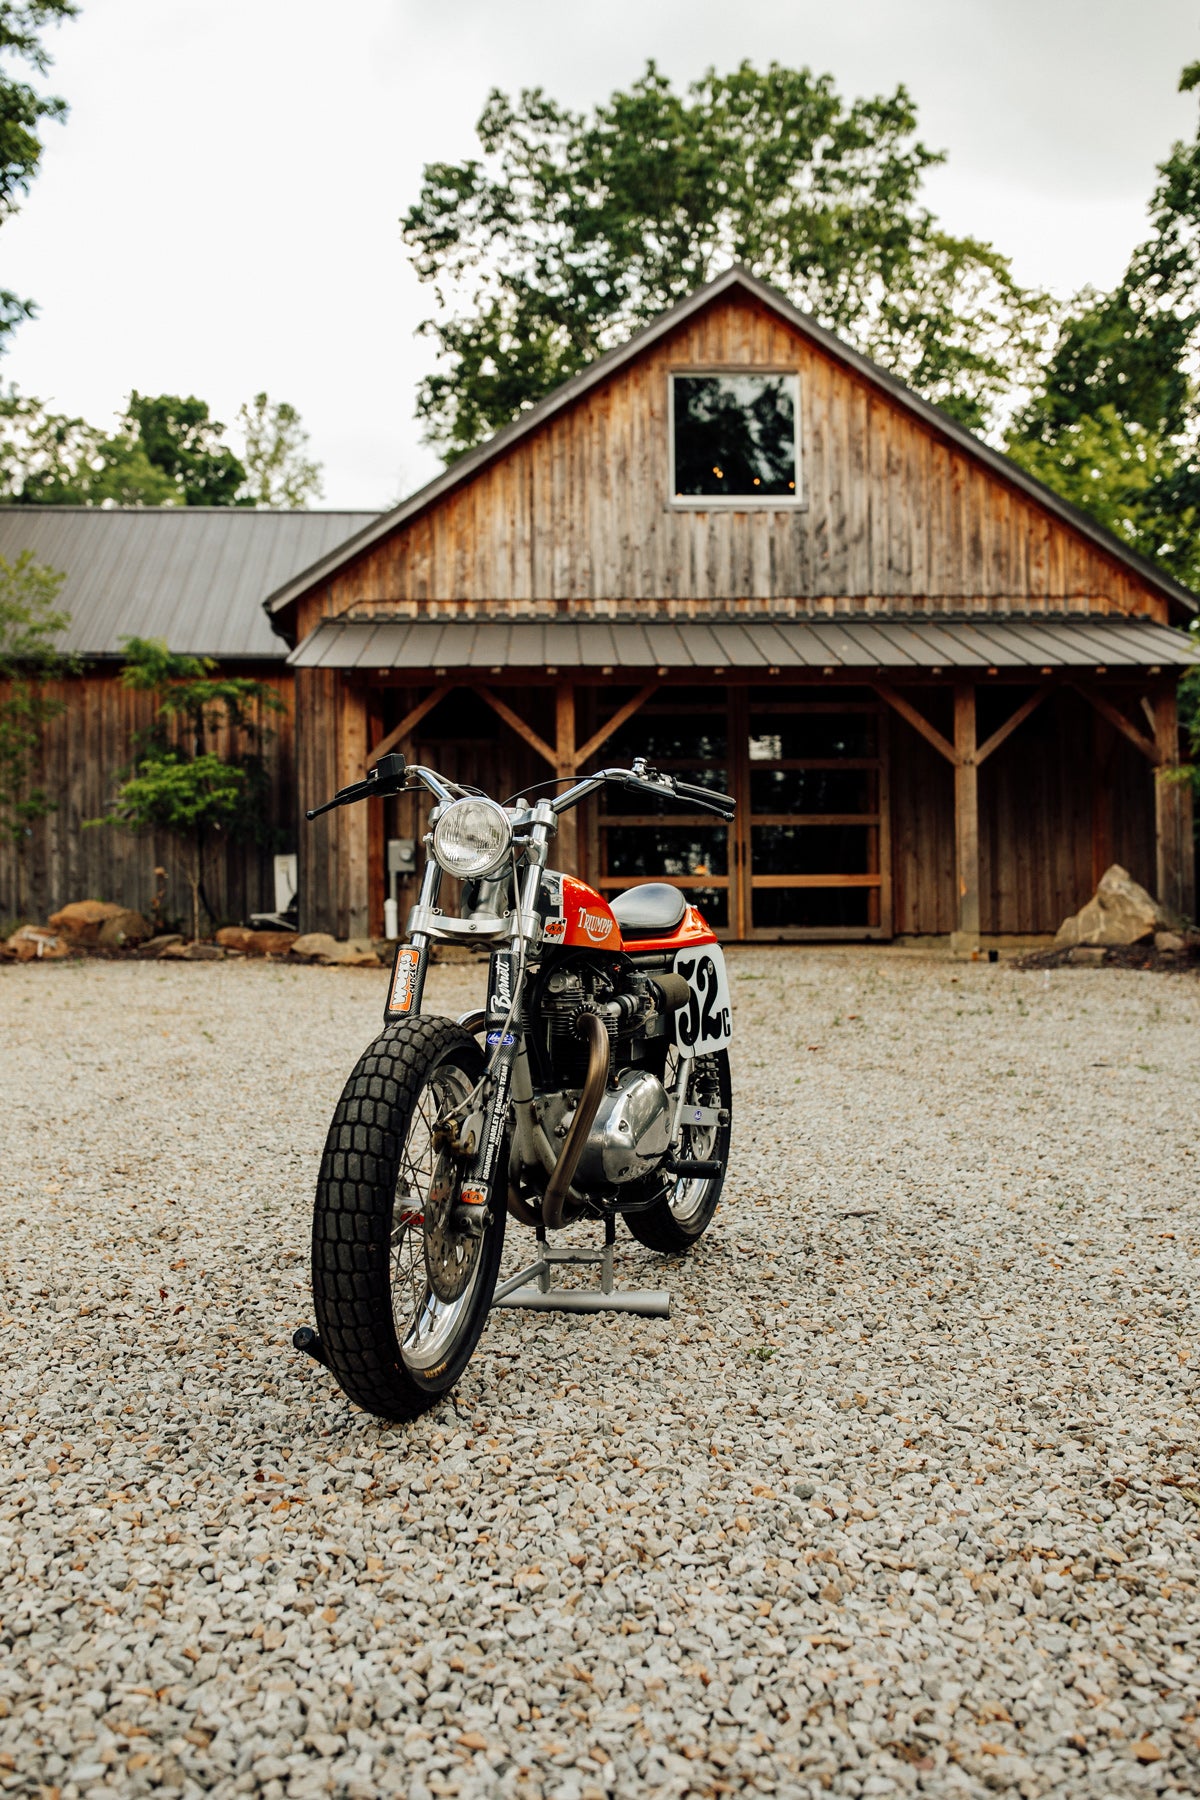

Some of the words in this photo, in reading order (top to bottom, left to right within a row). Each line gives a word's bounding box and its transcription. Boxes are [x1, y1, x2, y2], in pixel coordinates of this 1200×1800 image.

[578, 907, 612, 934] TRIUMPH
[392, 954, 412, 1005] WORKS
[490, 960, 512, 1013] Barnett
[499, 1065, 509, 1086] TEAM
[494, 1086, 505, 1114] RACING
[489, 1113, 500, 1143] HARLEY
[482, 1143, 495, 1180] GRANDMA
